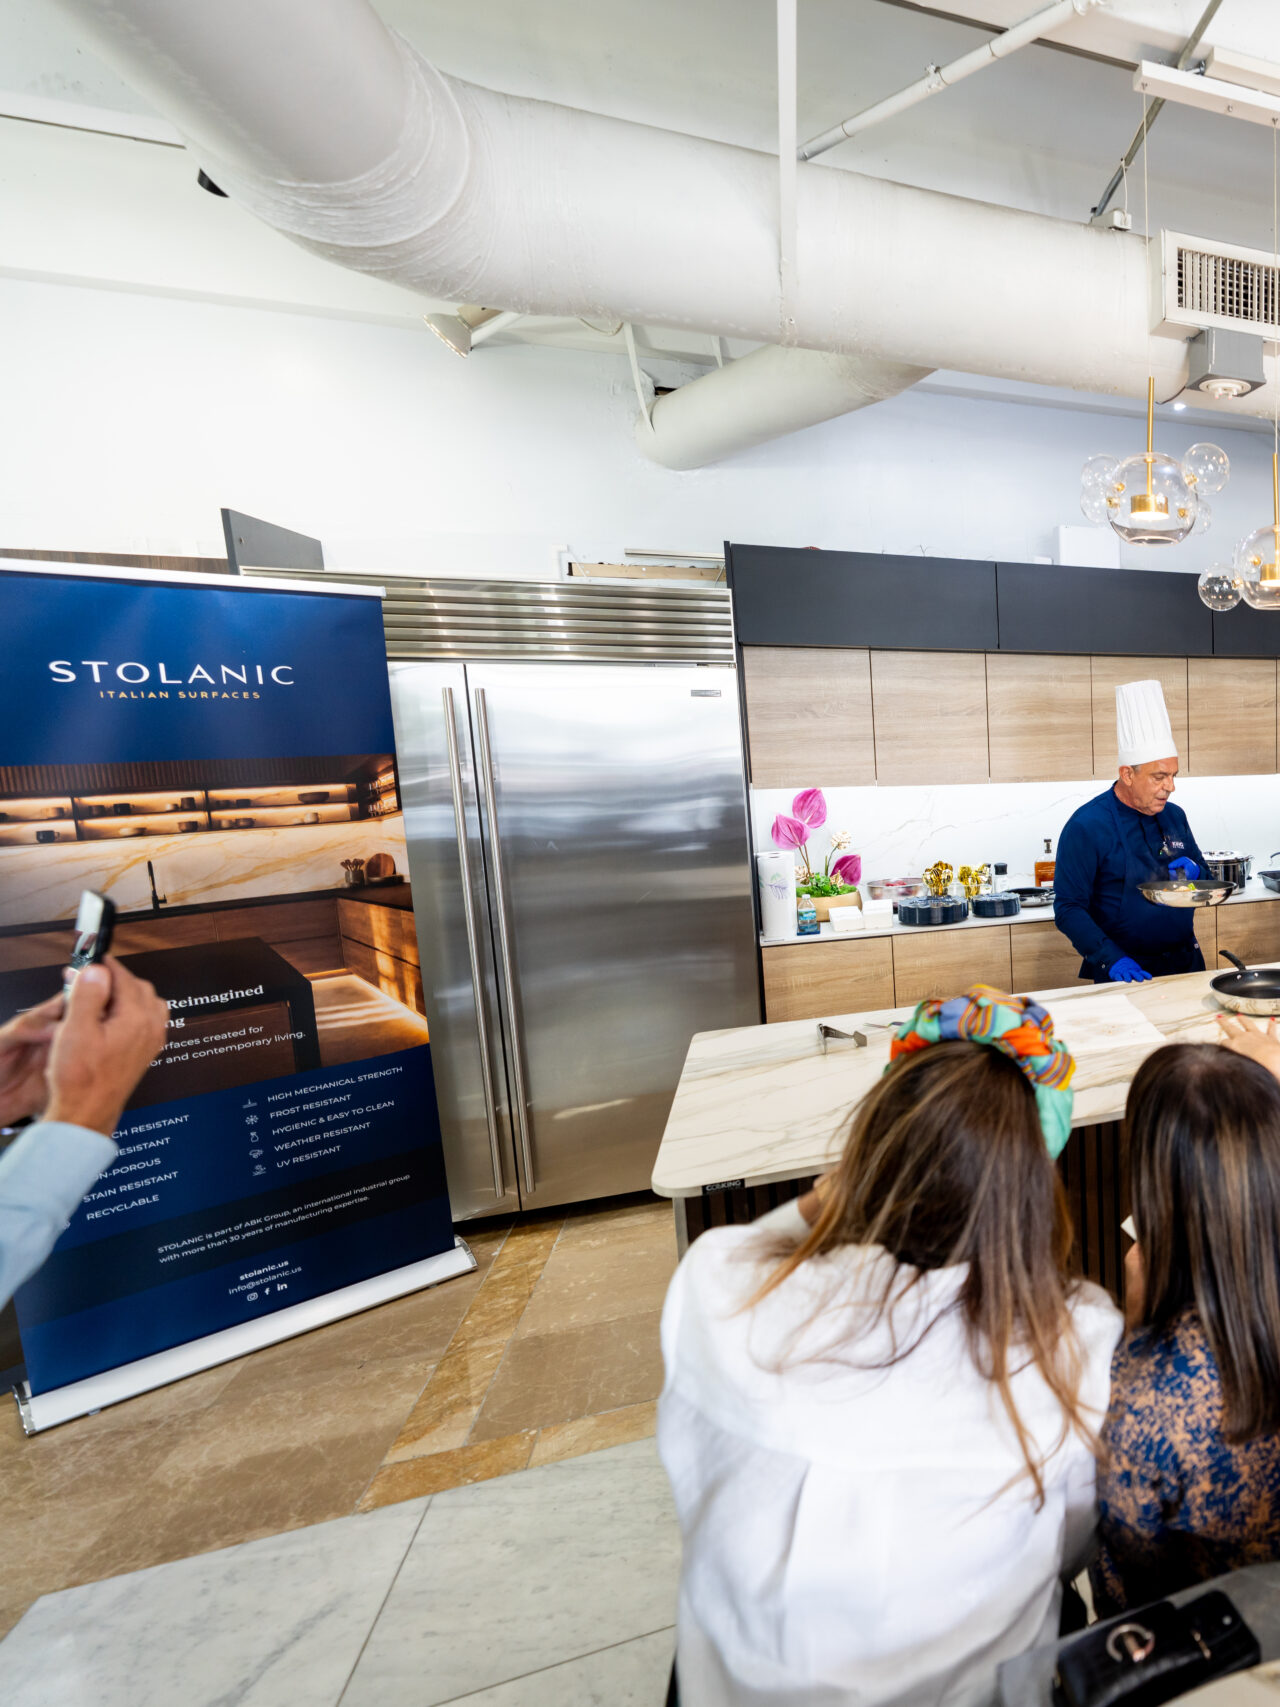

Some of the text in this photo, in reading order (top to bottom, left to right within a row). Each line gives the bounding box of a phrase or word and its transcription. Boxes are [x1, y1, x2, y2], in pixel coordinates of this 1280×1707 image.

[48, 660, 295, 685] STOLANIC
[99, 690, 261, 699] ITALIAN SURFACES
[166, 984, 264, 1010] Reimagined
[202, 1027, 246, 1044] created
[248, 1025, 264, 1034] for
[165, 1053, 189, 1065] and
[192, 1036, 272, 1059] contemporary
[274, 1031, 306, 1043] living.
[267, 1066, 403, 1103] HIGH MECHANICAL STRENGTH
[269, 1094, 352, 1119] FROST RESISTANT
[272, 1100, 395, 1136] HYGIENIC & EASY TO CLEAN
[130, 1114, 190, 1135] RESISTANT
[274, 1122, 371, 1152] WEATHER RESISTANT
[97, 1157, 161, 1181] N-POROUS
[276, 1145, 342, 1168] UV RESISTANT
[83, 1171, 179, 1203] STAIN RESISTANT
[86, 1194, 160, 1221] RECYCLABLE
[157, 1235, 204, 1254] STOLANIC
[214, 1227, 232, 1238] part
[234, 1223, 243, 1231] of
[244, 1218, 262, 1228] ABK
[264, 1209, 292, 1222] Group,
[304, 1190, 352, 1210] international
[353, 1181, 388, 1195] industrial
[388, 1174, 410, 1186] group
[159, 1253, 180, 1264] with
[182, 1246, 206, 1257] more
[207, 1238, 228, 1249] than
[229, 1234, 240, 1243] 30
[241, 1229, 263, 1241] years
[274, 1207, 333, 1229] manufacturing
[333, 1196, 370, 1211] expertise.
[228, 1266, 302, 1295] info@stolanic.us
[239, 1260, 289, 1281] stolanic.us
